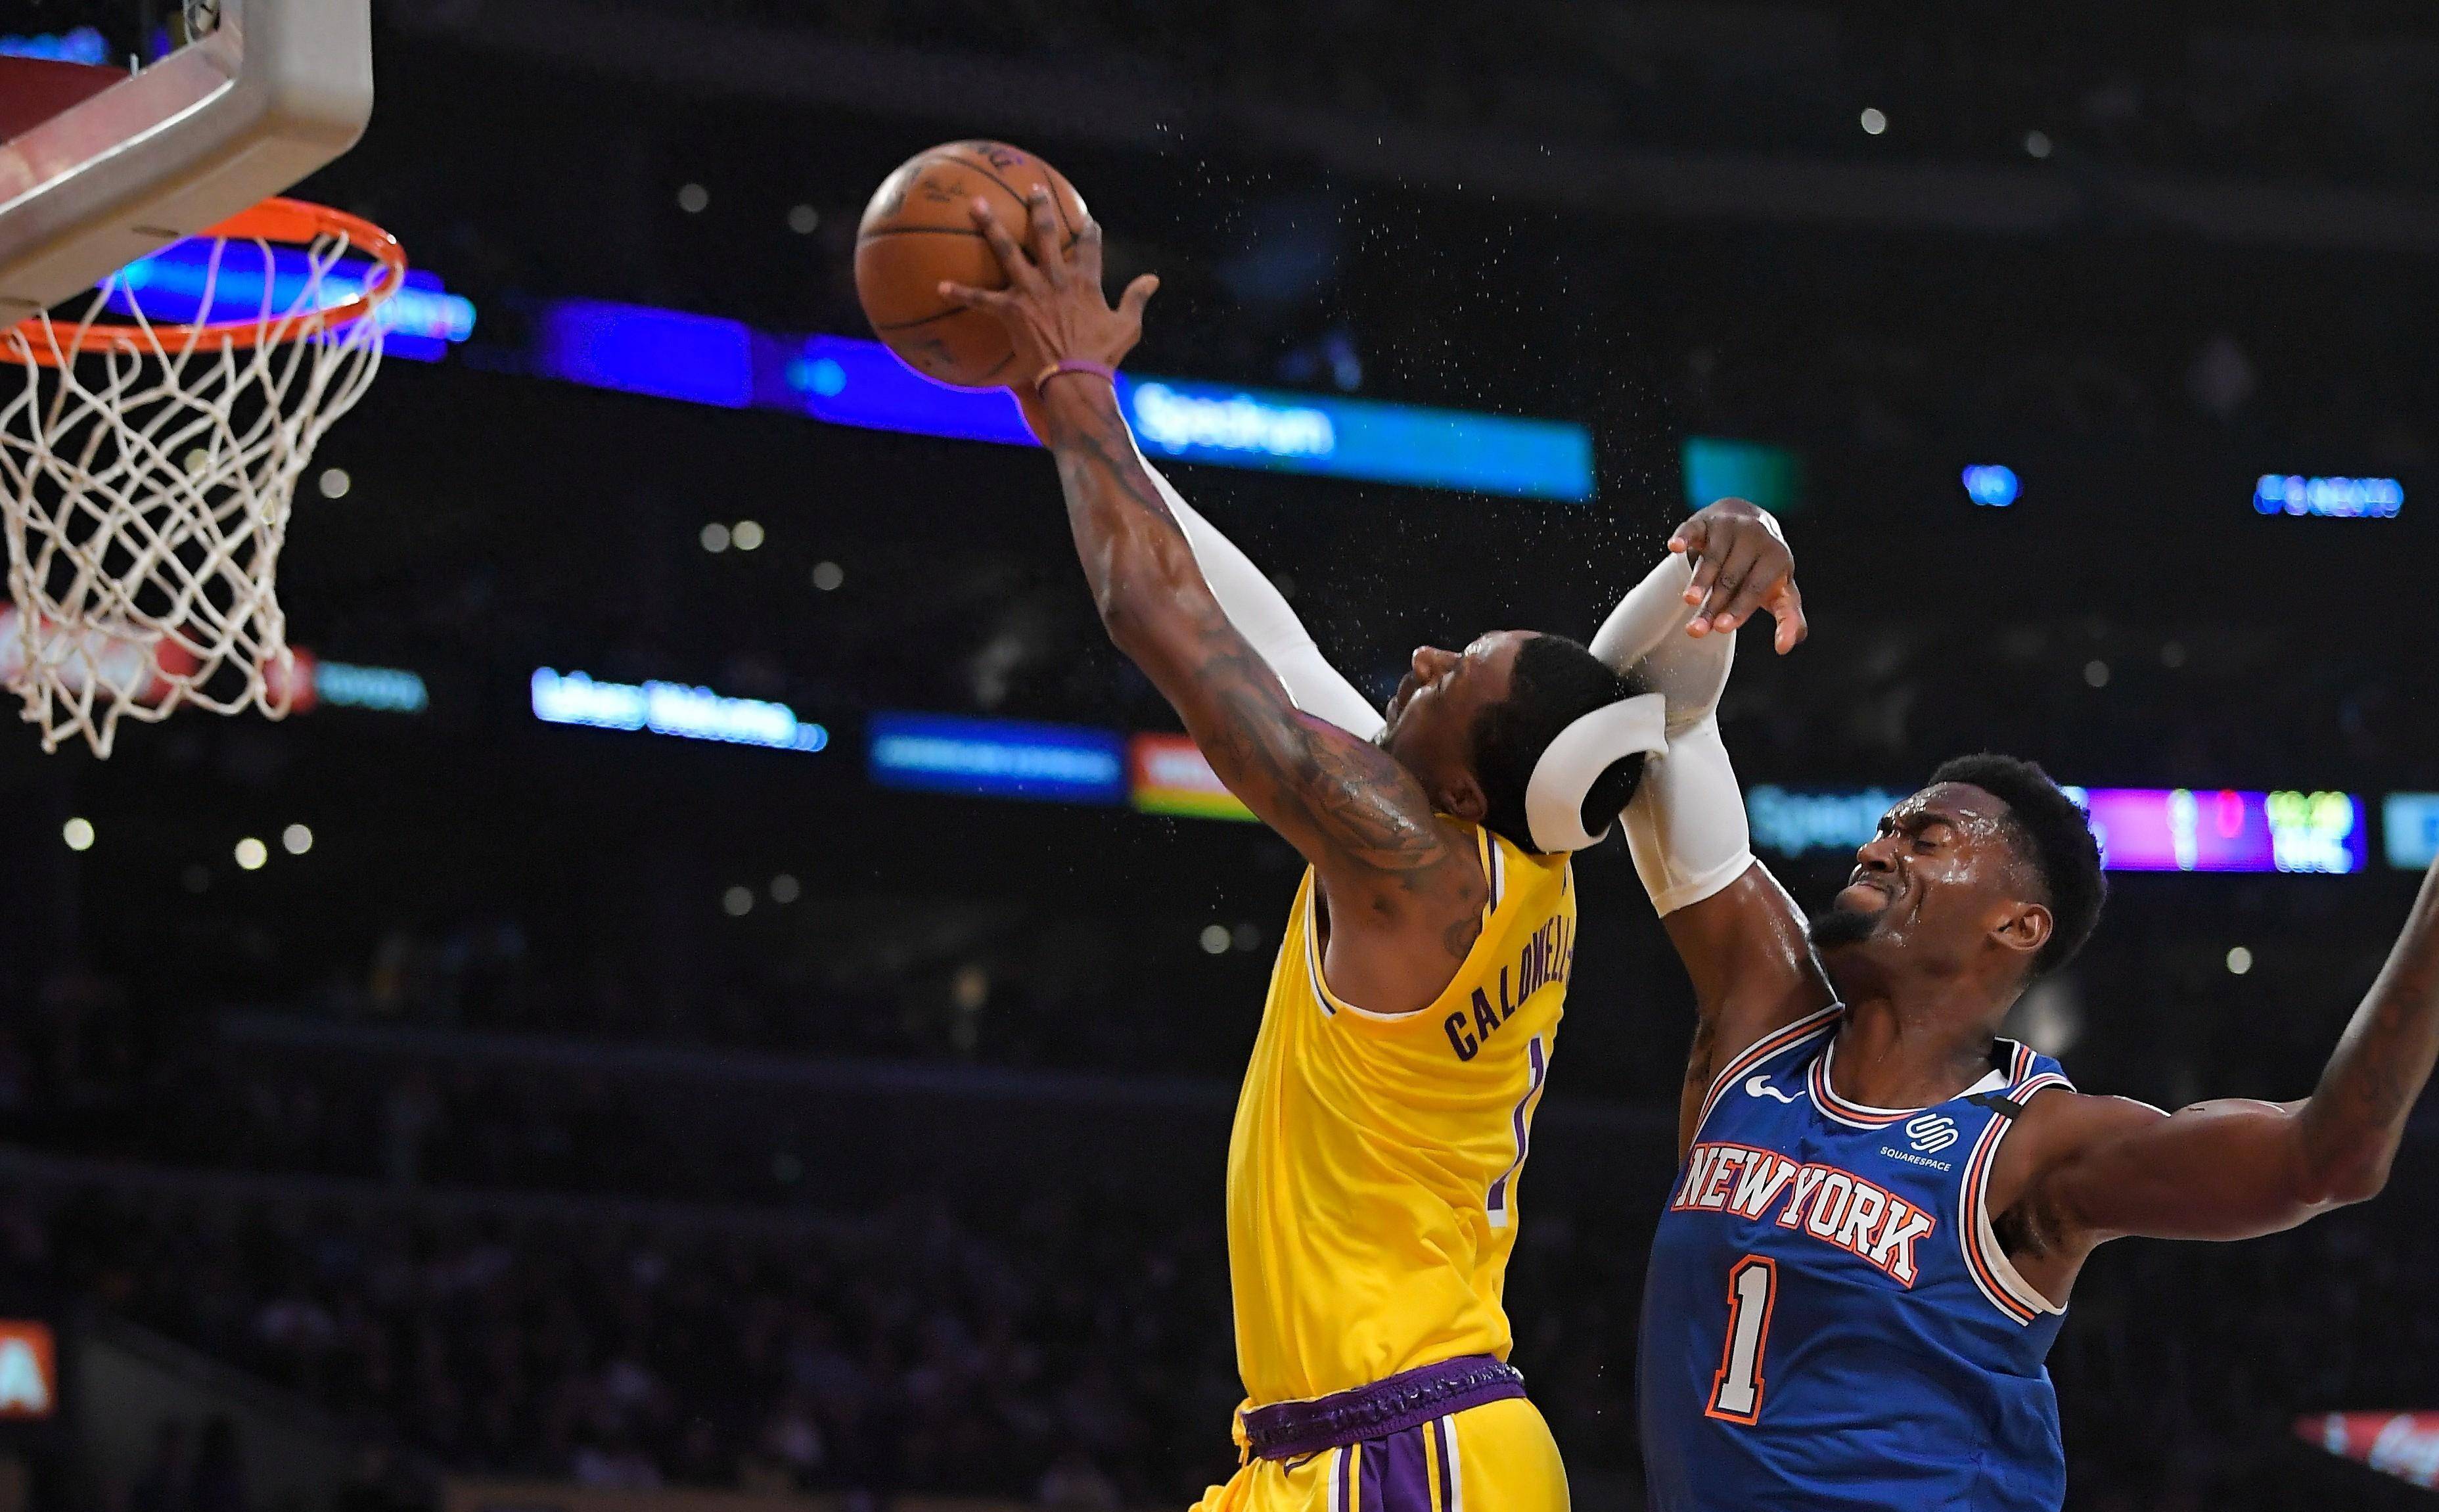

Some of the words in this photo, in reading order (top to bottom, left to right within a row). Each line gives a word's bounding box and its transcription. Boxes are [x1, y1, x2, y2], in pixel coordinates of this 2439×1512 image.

[1671, 1142, 1796, 1220] NEW
[1776, 1163, 1936, 1289] YORK
[1880, 1146, 1951, 1172] SQUARESPACE
[1704, 1254, 1777, 1426] 1
